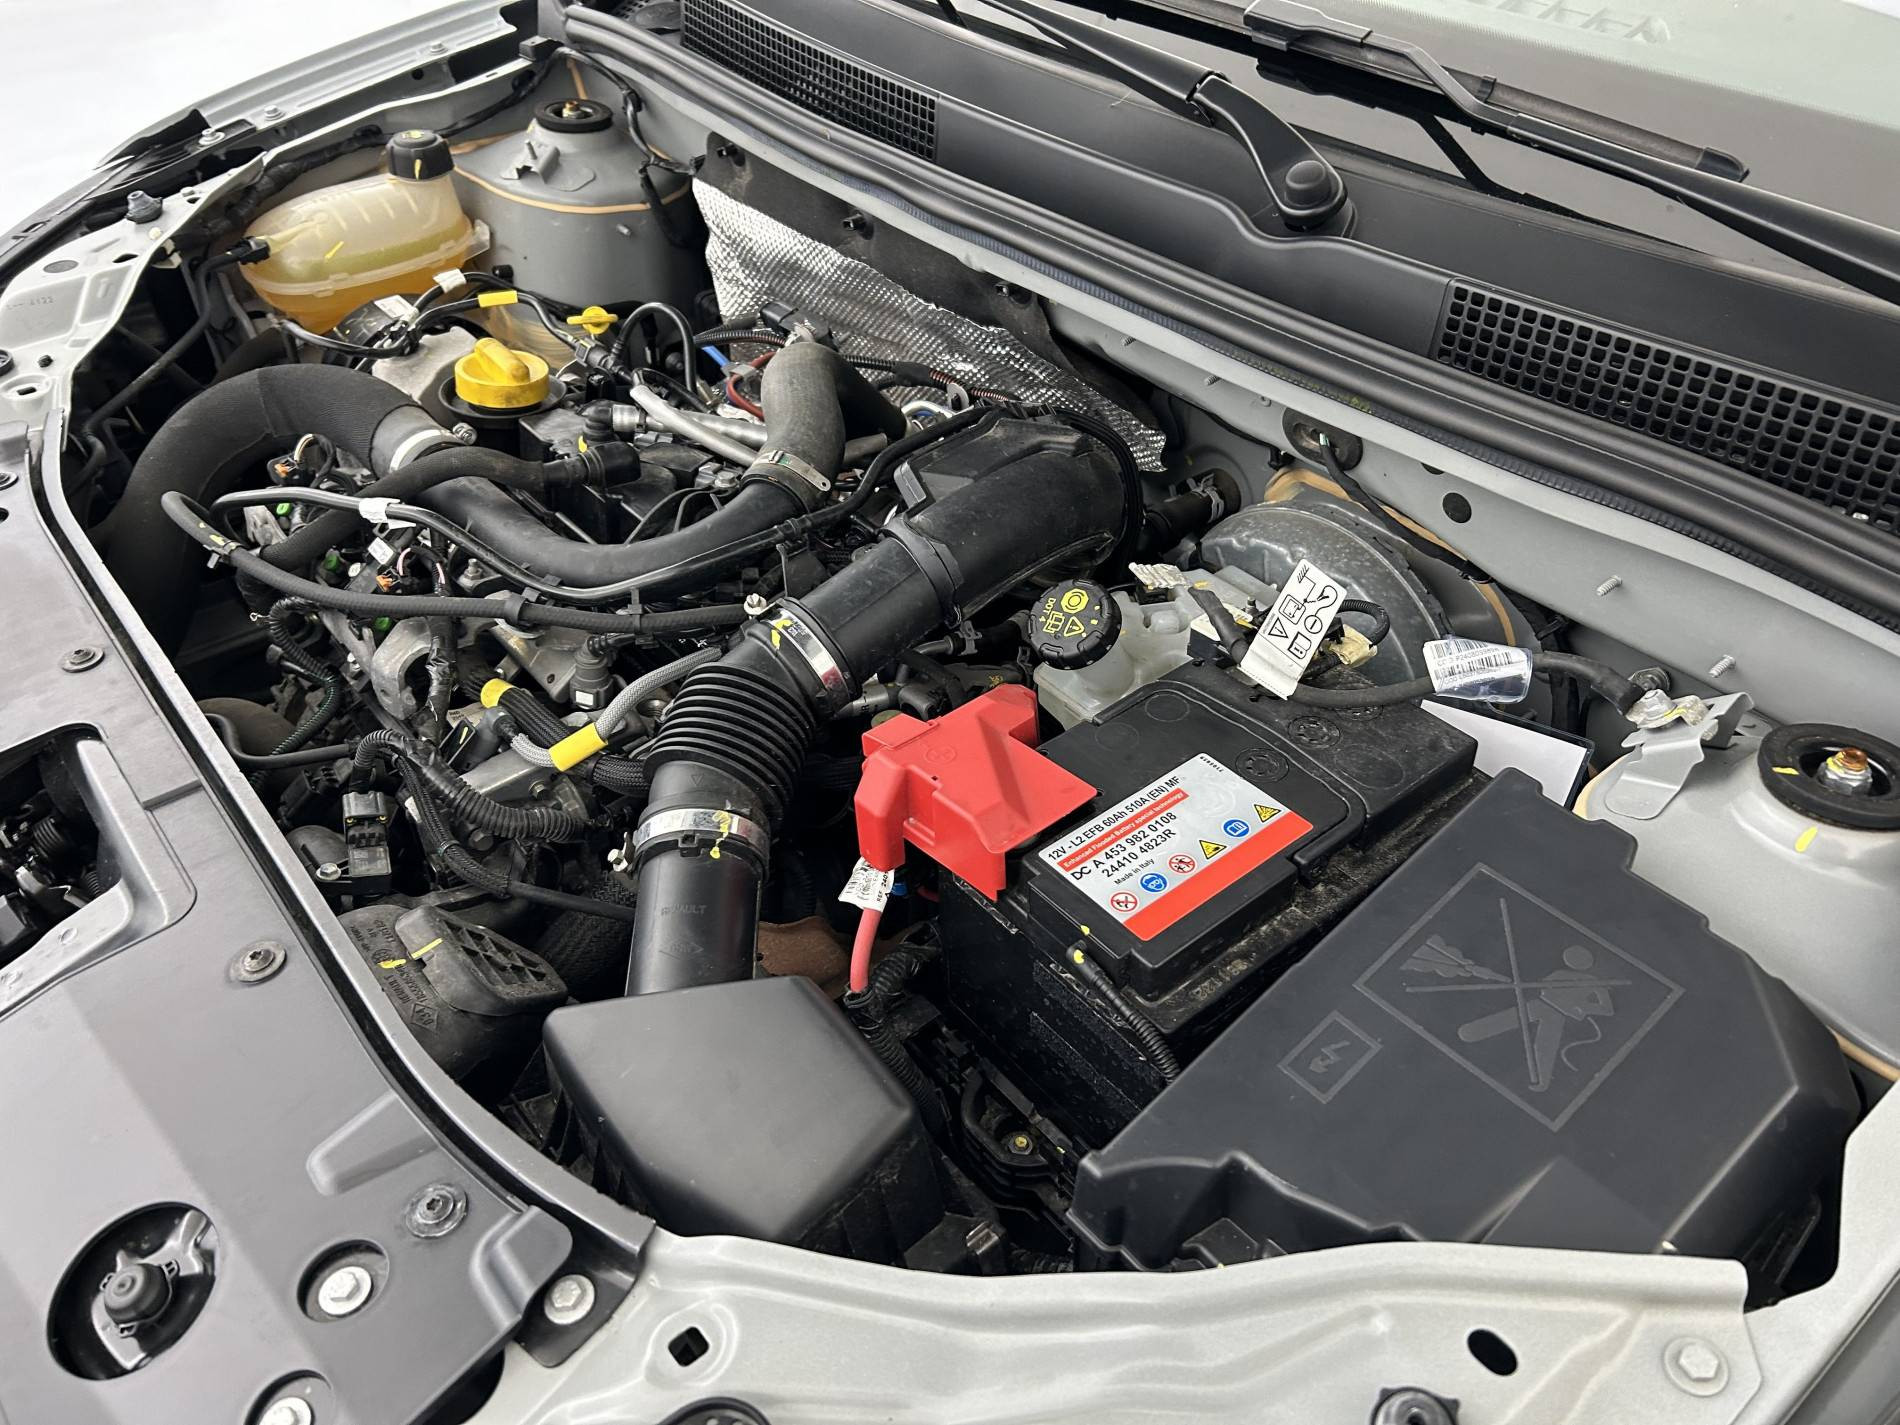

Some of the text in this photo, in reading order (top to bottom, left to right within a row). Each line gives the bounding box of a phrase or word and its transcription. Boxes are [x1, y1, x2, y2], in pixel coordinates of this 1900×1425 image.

[1043, 598, 1056, 615] DOT
[1048, 846, 1066, 860] 12V
[1070, 835, 1086, 847] L2
[1082, 824, 1105, 839] EFB
[1102, 810, 1128, 827] 60Ah
[1125, 797, 1151, 813] 510A
[1147, 785, 1169, 801] (EN)
[1164, 776, 1180, 788] MF
[1063, 847, 1094, 867] Enhanced
[1113, 822, 1136, 837] Battery
[1135, 810, 1155, 824] special
[1152, 791, 1184, 812] technology
[1071, 812, 1177, 880] DC A 453 982 0108
[1101, 828, 1176, 878] 24410 4823R
[1114, 872, 1133, 885] Made
[1139, 858, 1155, 870] Italy
